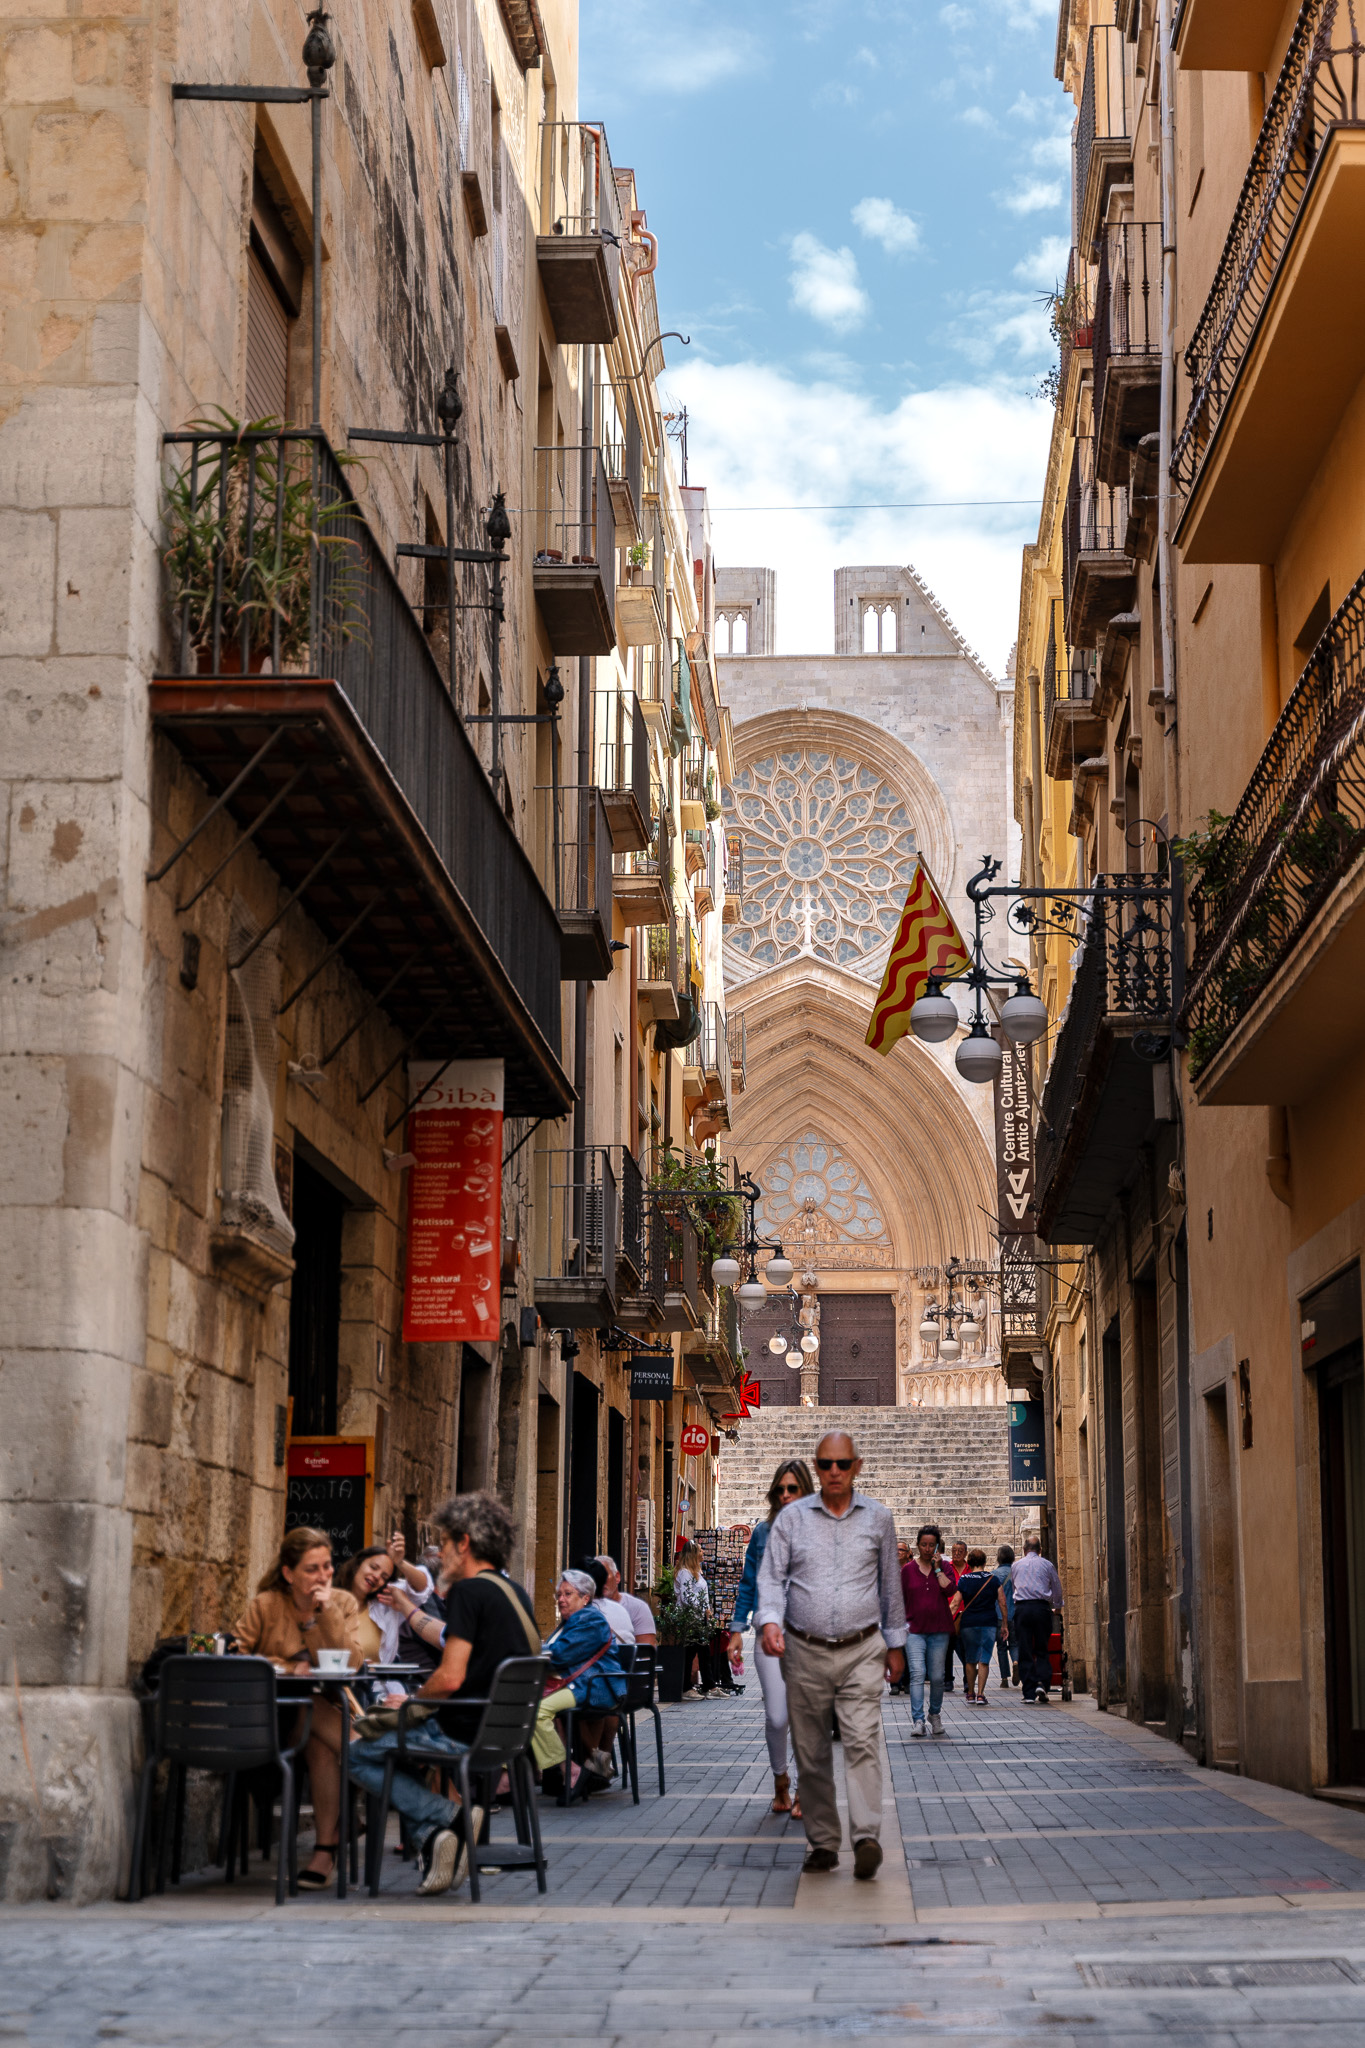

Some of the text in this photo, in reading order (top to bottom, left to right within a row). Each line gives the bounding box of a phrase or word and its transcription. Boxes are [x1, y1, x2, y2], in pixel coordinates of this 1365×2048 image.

[416, 1088, 496, 1104] Dibà
[1015, 1041, 1031, 1161] Antic Ajuntamen
[1000, 1051, 1016, 1162] Centre Cultural
[415, 1120, 461, 1128] Entrepans
[412, 1218, 455, 1226] Pastissos
[412, 1274, 461, 1283] Suc natural
[634, 1371, 670, 1379] PERSONAL
[683, 1427, 706, 1444] ria
[304, 1457, 330, 1465] Estrella
